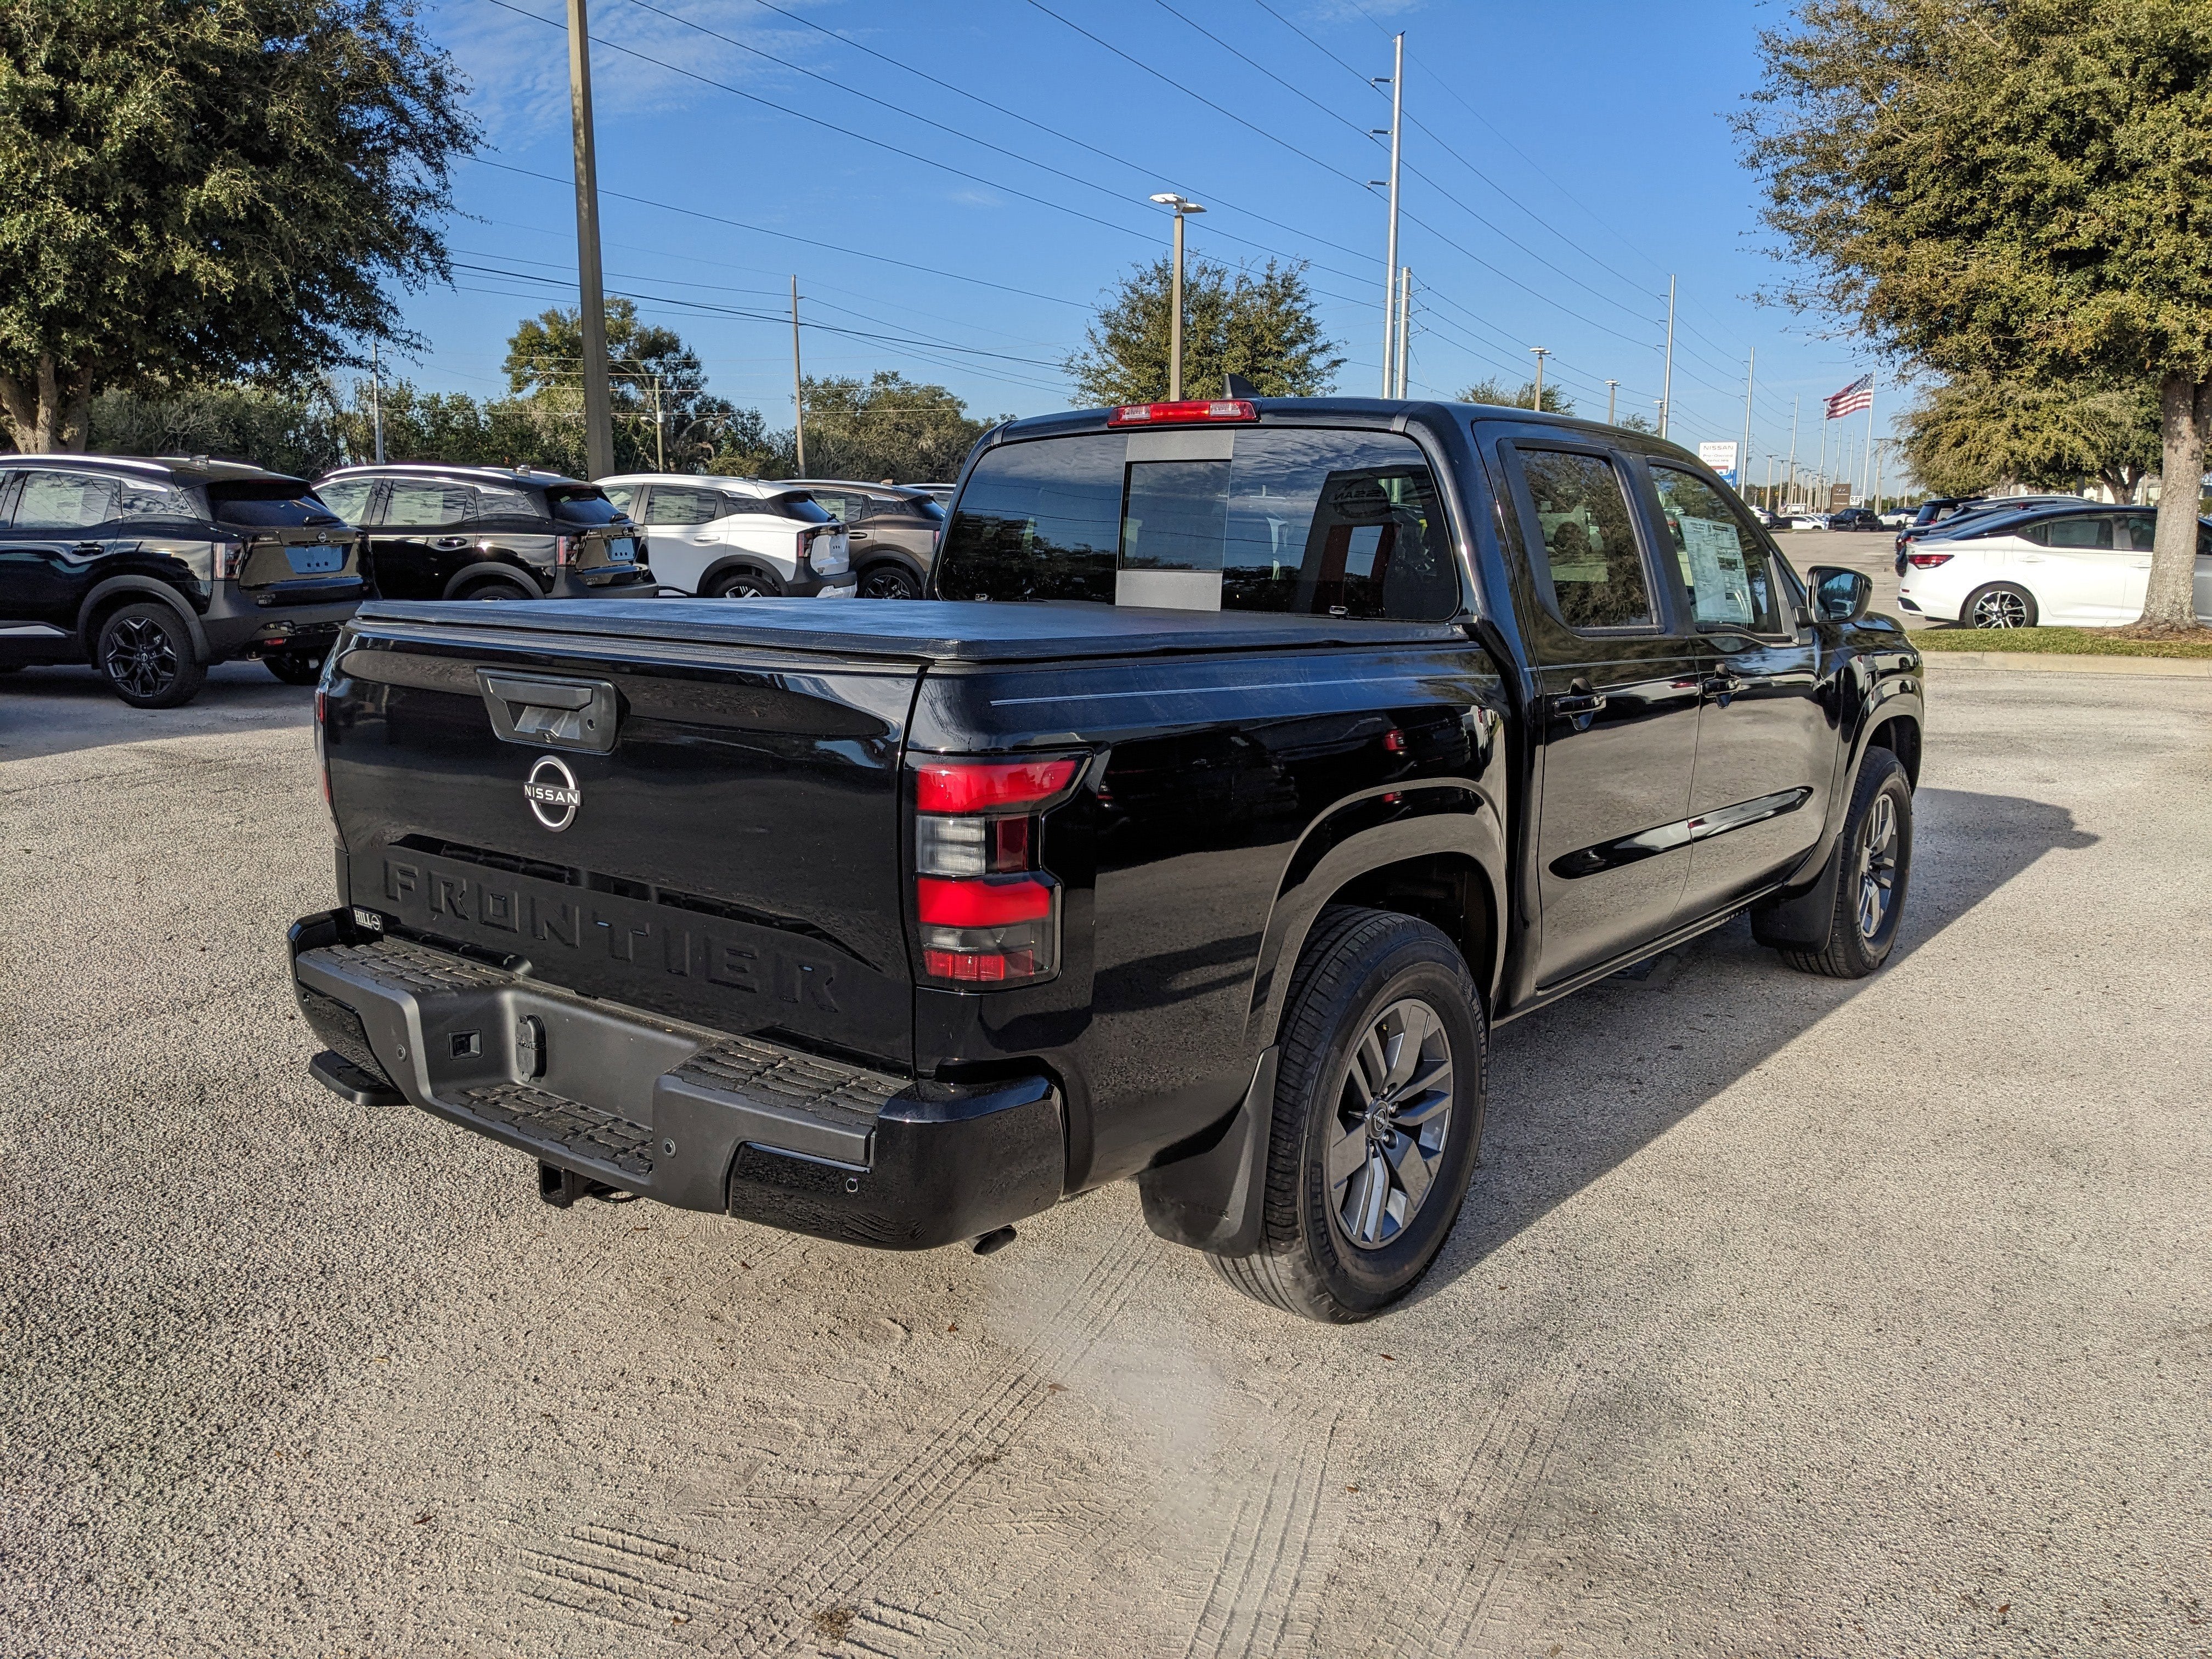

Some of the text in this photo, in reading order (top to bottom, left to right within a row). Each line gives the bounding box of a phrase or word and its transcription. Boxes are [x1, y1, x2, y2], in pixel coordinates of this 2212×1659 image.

[524, 785, 578, 804] NISSAN
[354, 910, 372, 926] HILL
[382, 857, 839, 1013] FRONTIER
[1471, 997, 1487, 1092] MICHELIN
[1311, 1167, 1337, 1268] MICHELIN
